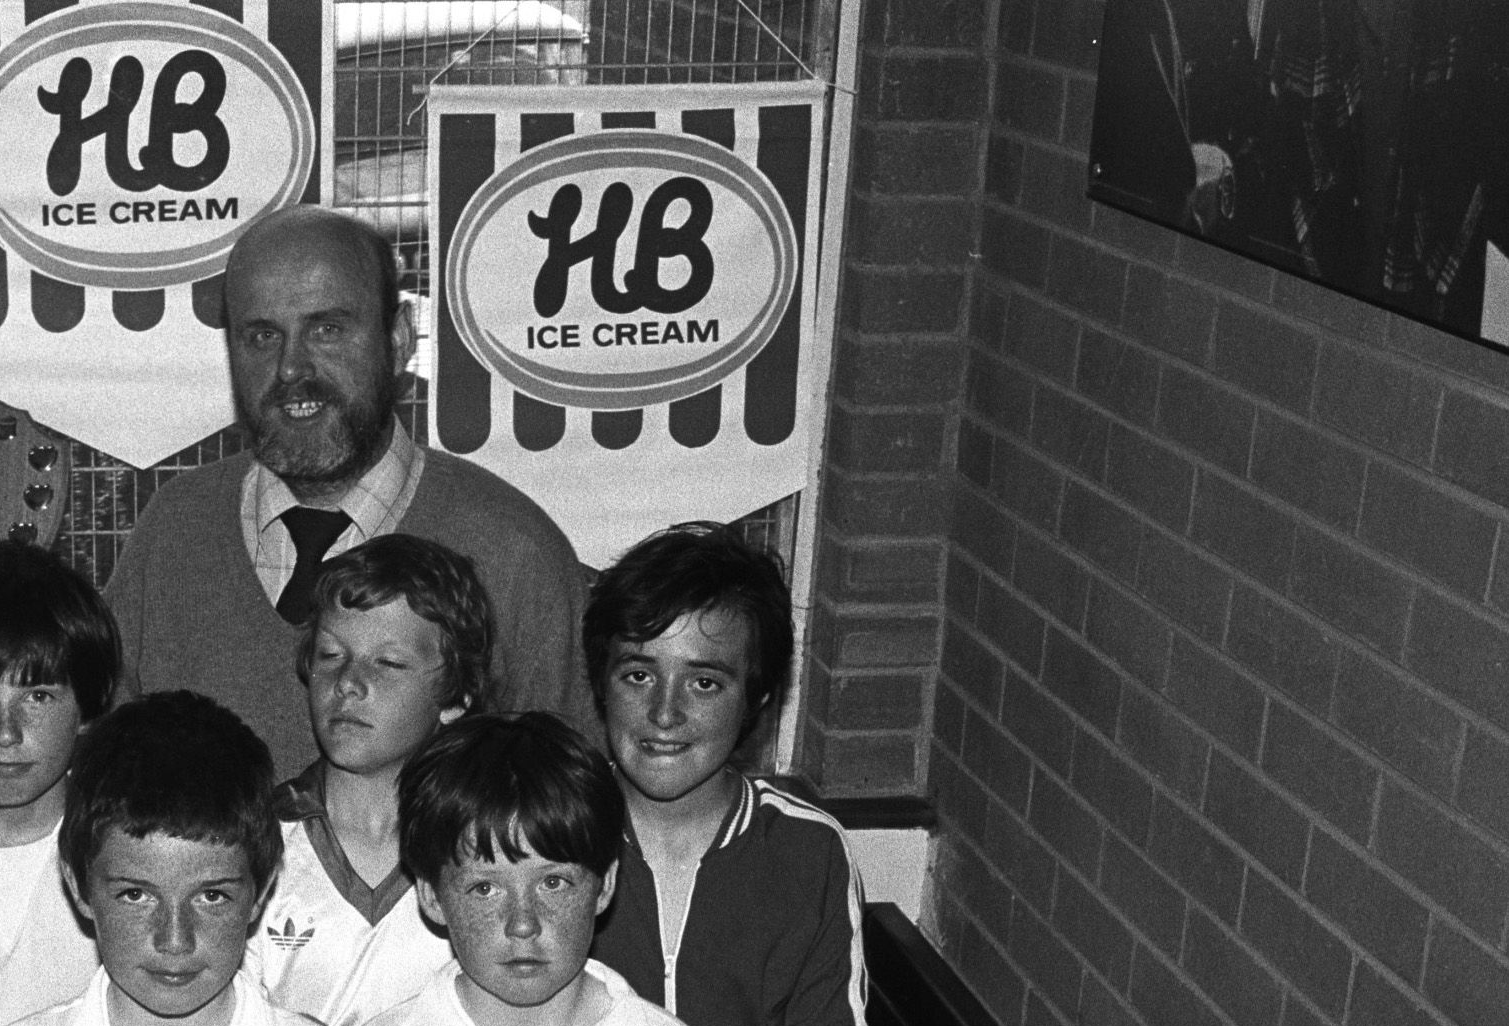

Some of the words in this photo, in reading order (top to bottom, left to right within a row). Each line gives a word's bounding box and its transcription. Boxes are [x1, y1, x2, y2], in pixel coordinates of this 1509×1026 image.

[37, 49, 230, 197] HB
[42, 202, 97, 226] ICE
[109, 197, 238, 224] CREAM
[527, 176, 715, 318] HB
[527, 324, 581, 349] ICE
[592, 319, 719, 347] CREAM
